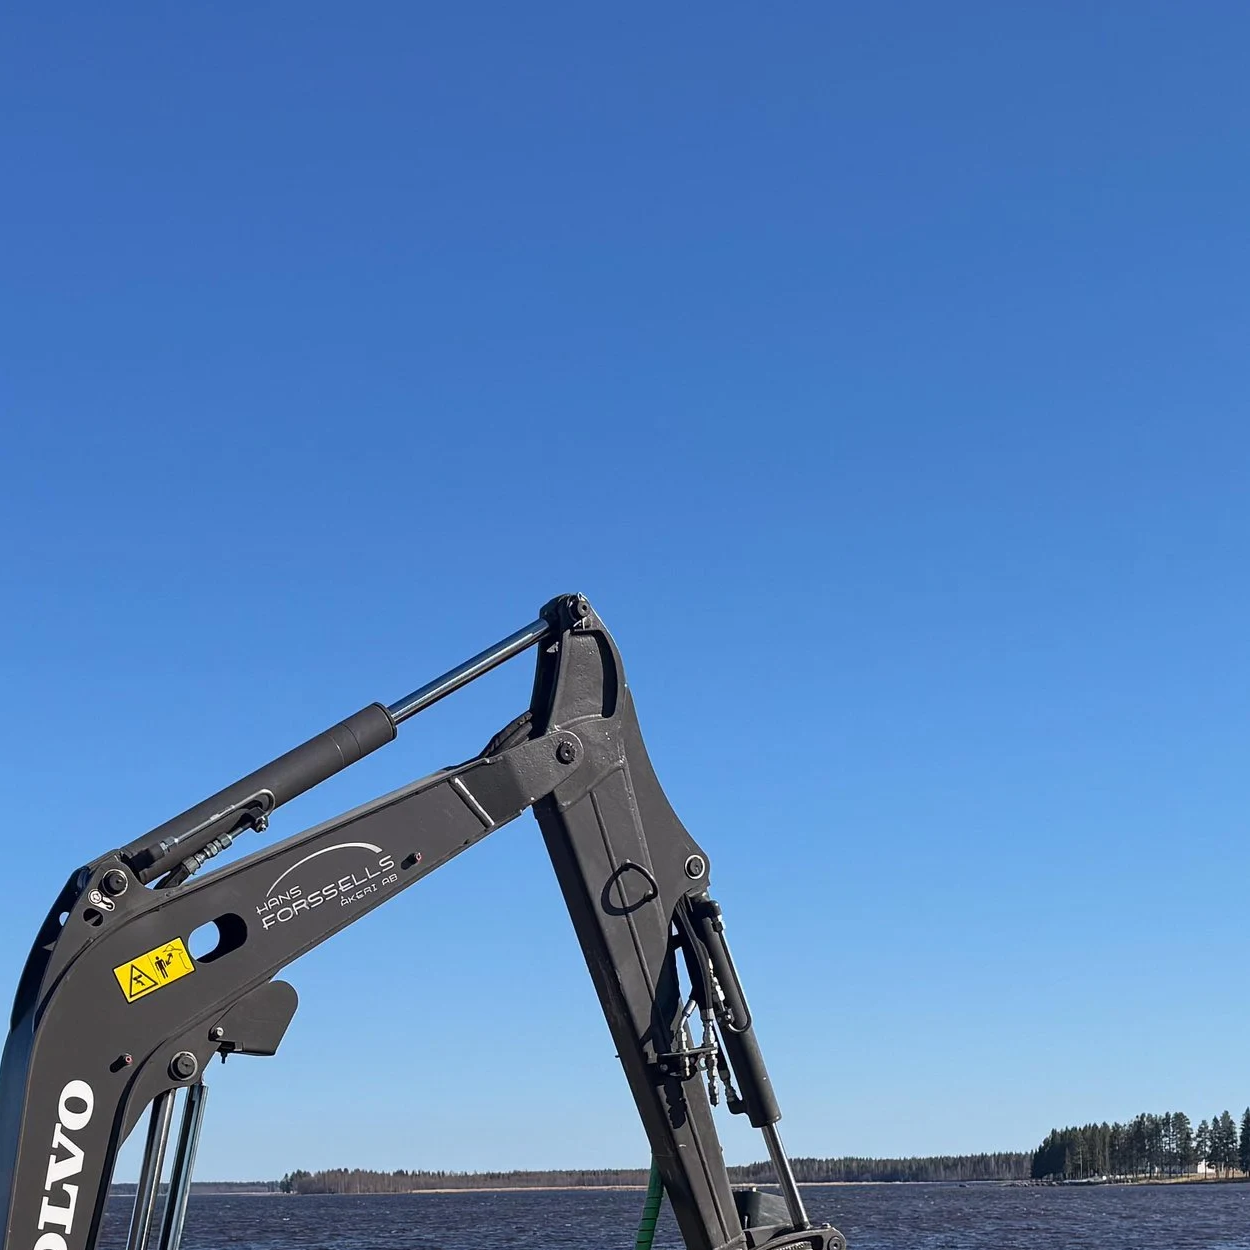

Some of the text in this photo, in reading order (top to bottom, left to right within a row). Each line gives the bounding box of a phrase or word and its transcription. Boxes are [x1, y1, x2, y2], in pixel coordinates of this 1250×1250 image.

[262, 855, 394, 930] FORSSELLS
[381, 873, 398, 886] AB
[256, 885, 301, 915] HANS
